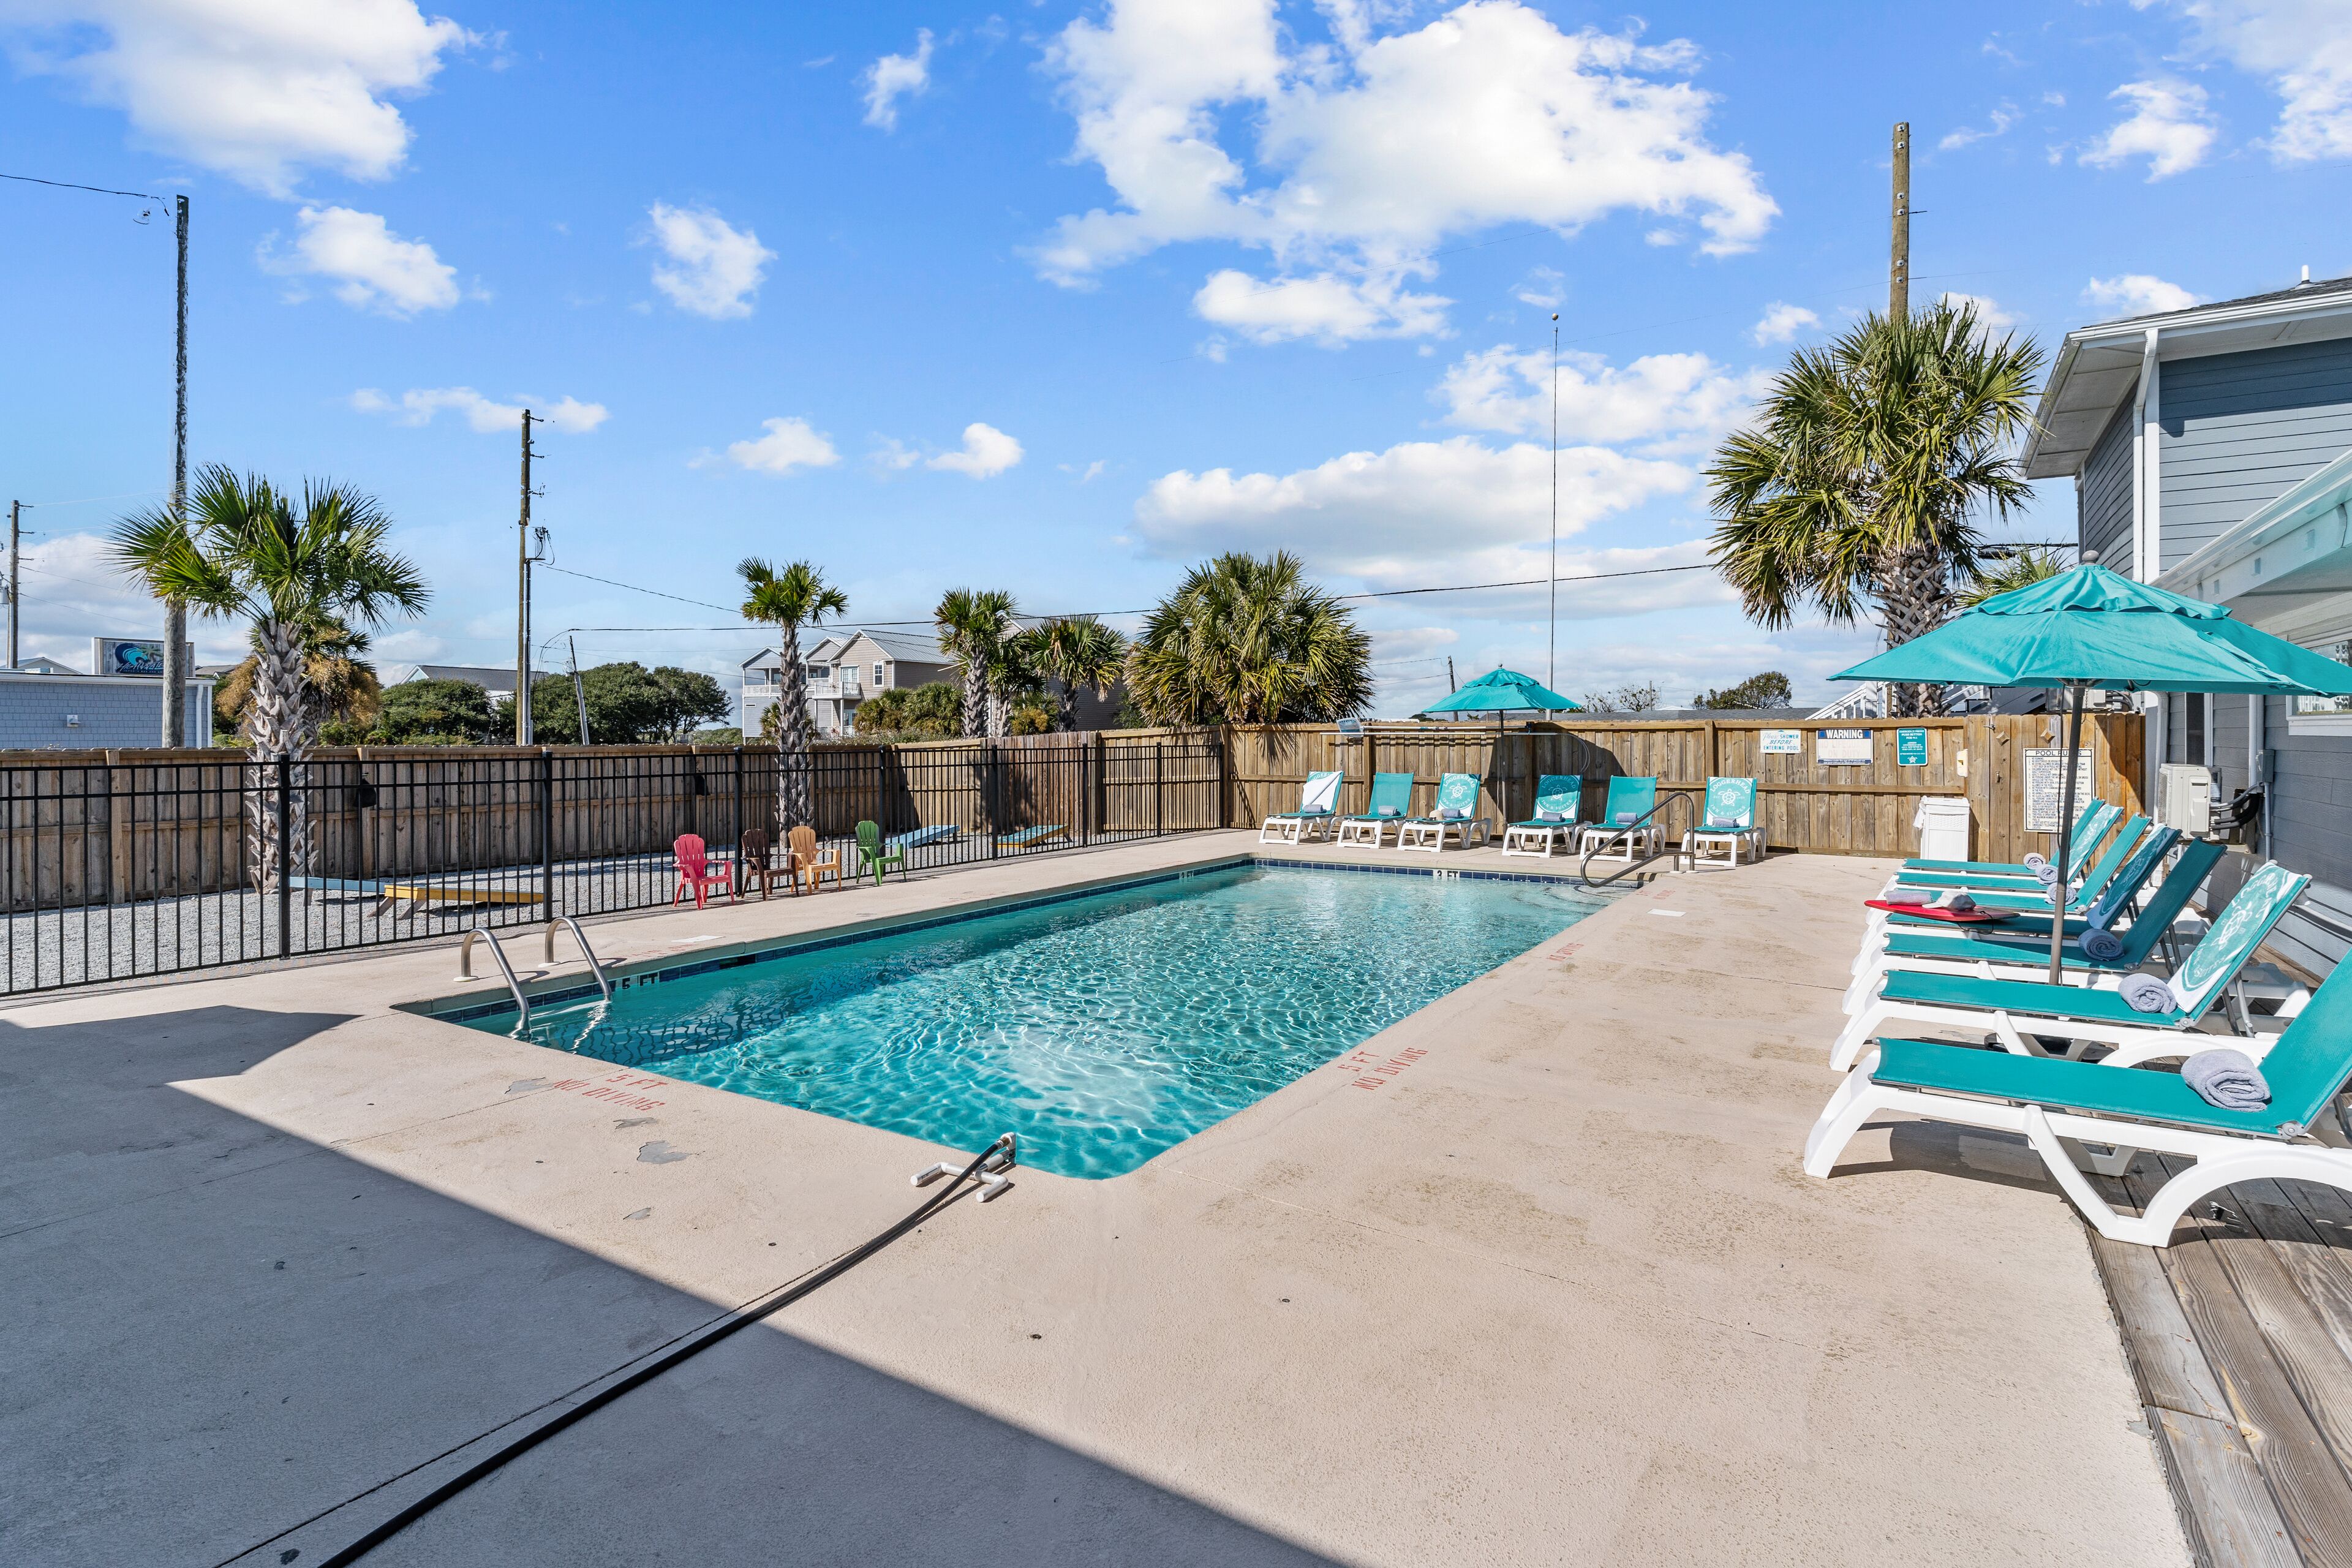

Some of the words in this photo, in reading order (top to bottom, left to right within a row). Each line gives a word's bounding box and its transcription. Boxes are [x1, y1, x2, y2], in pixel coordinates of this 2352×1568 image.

[111, 659, 164, 672] HIGHWATE
[1826, 729, 1863, 739] WARNING
[1444, 775, 1475, 788] LOGGERHEAD
[1542, 775, 1576, 789] LOGGERHEAD
[1710, 778, 1750, 794] LOGGERHEAD
[622, 977, 630, 989] 5
[639, 973, 658, 986] FT
[1349, 1051, 1380, 1063] FT
[1351, 1076, 1387, 1090] NO
[1374, 1047, 1428, 1076] DIVING
[605, 1074, 635, 1083] 5
[625, 1079, 669, 1090] FT
[552, 1079, 591, 1091] NO
[582, 1087, 666, 1111] DIVING
